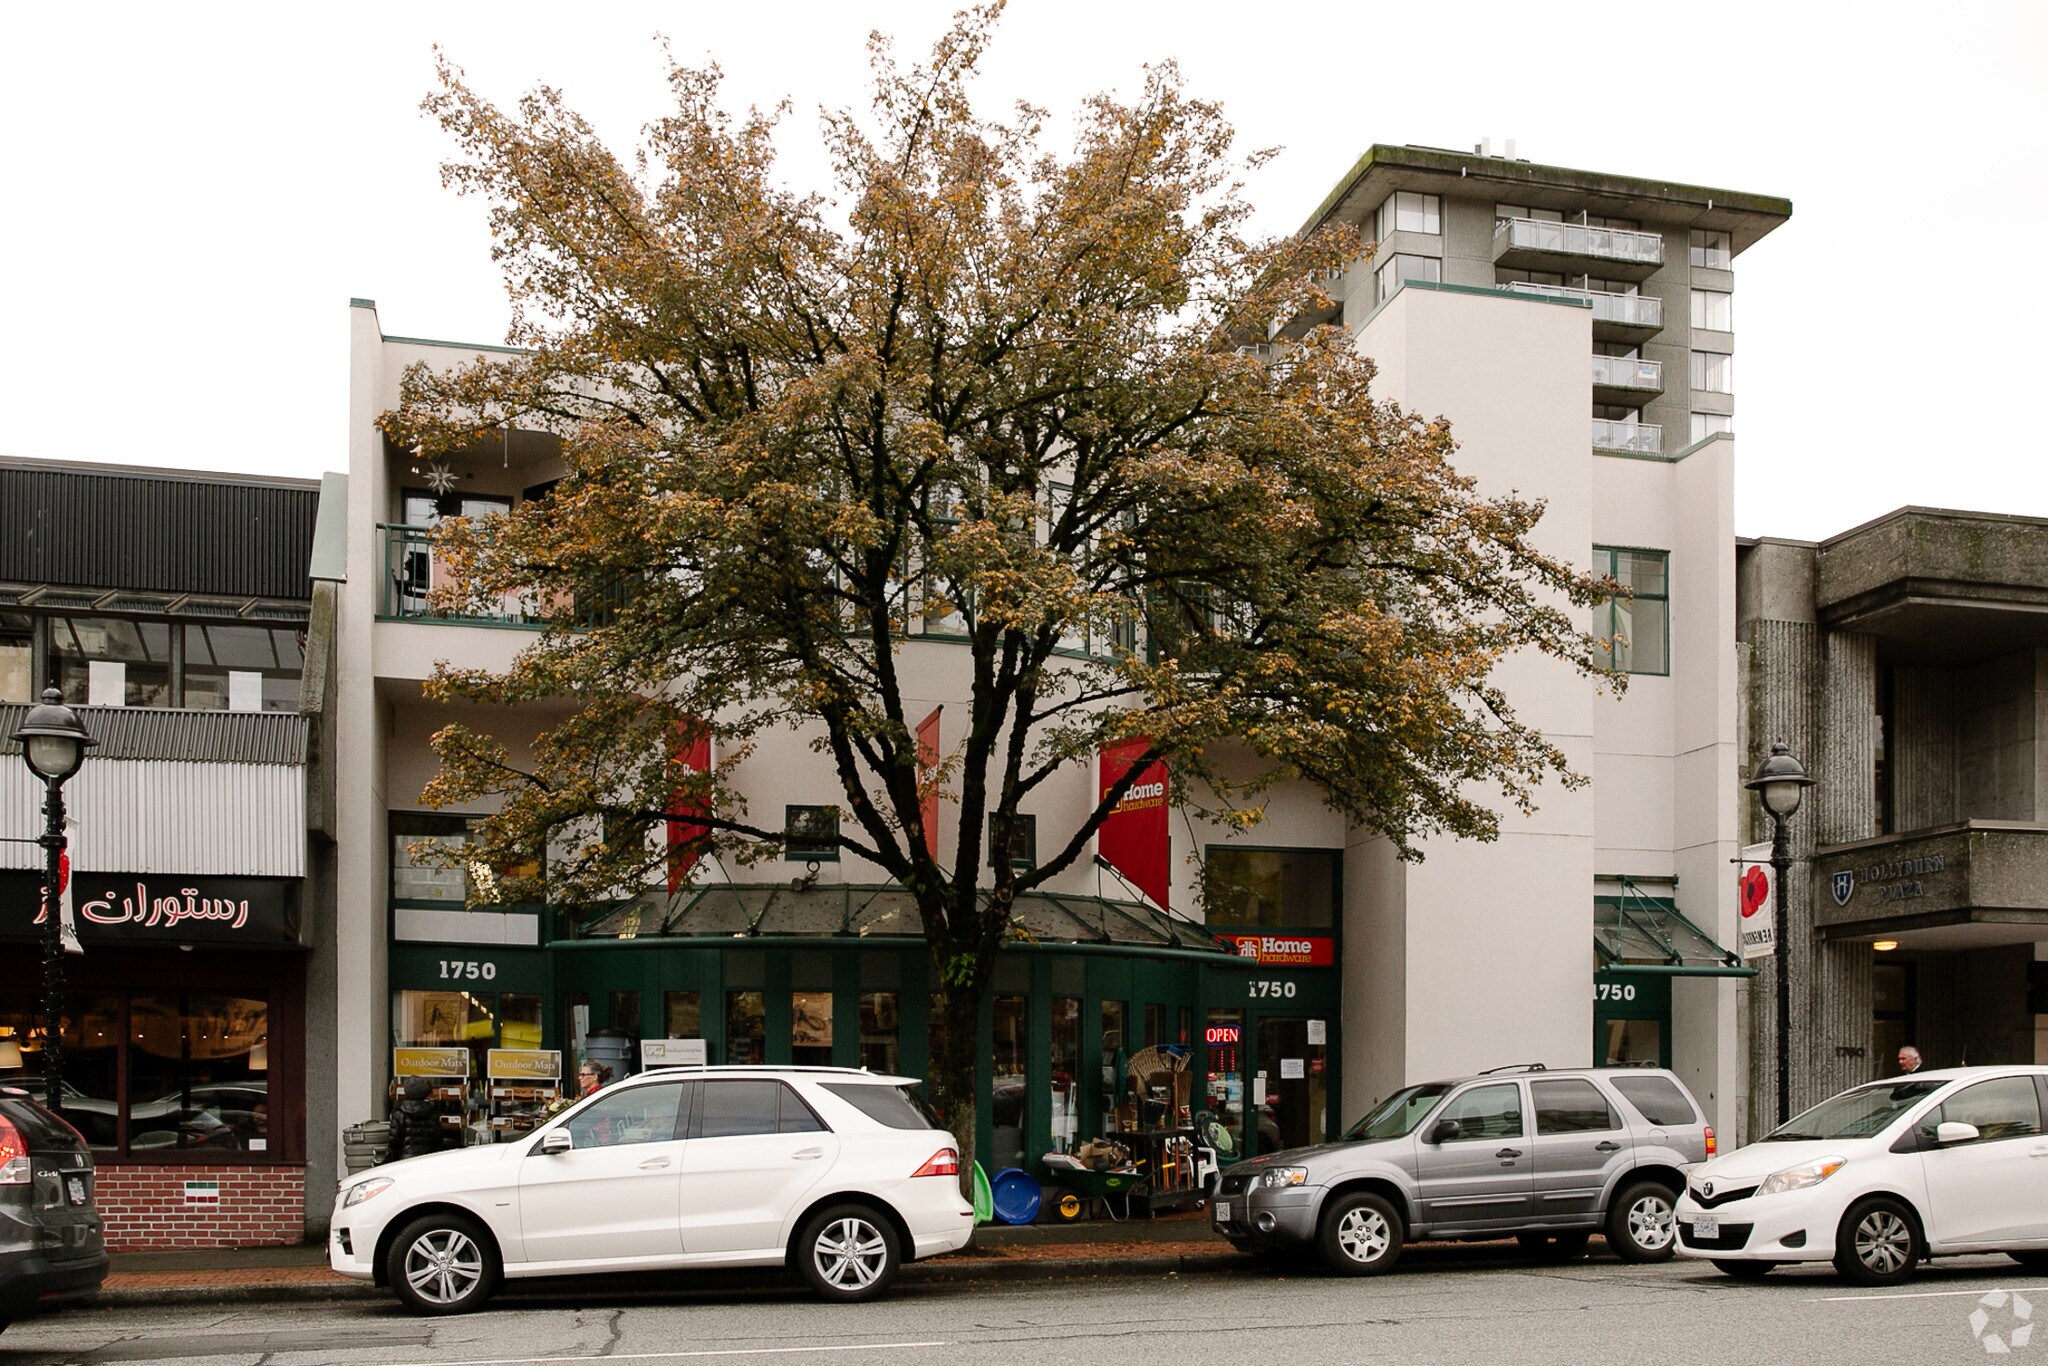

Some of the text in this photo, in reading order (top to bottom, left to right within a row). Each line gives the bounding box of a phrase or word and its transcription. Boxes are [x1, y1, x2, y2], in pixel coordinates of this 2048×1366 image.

[1123, 797, 1164, 812] hardware
[1859, 855, 1944, 883] HOLLYBURN
[1878, 881, 1925, 902] PLAZA
[82, 882, 249, 929] رستوران
[1261, 937, 1312, 954] Home
[1261, 953, 1312, 963] hardware
[439, 960, 497, 980] 1750
[1248, 981, 1297, 998] 1750
[1206, 1027, 1239, 1043] OPEN
[400, 1057, 464, 1068] Outdoor Mats
[494, 1059, 556, 1070] Outdoor Mats
